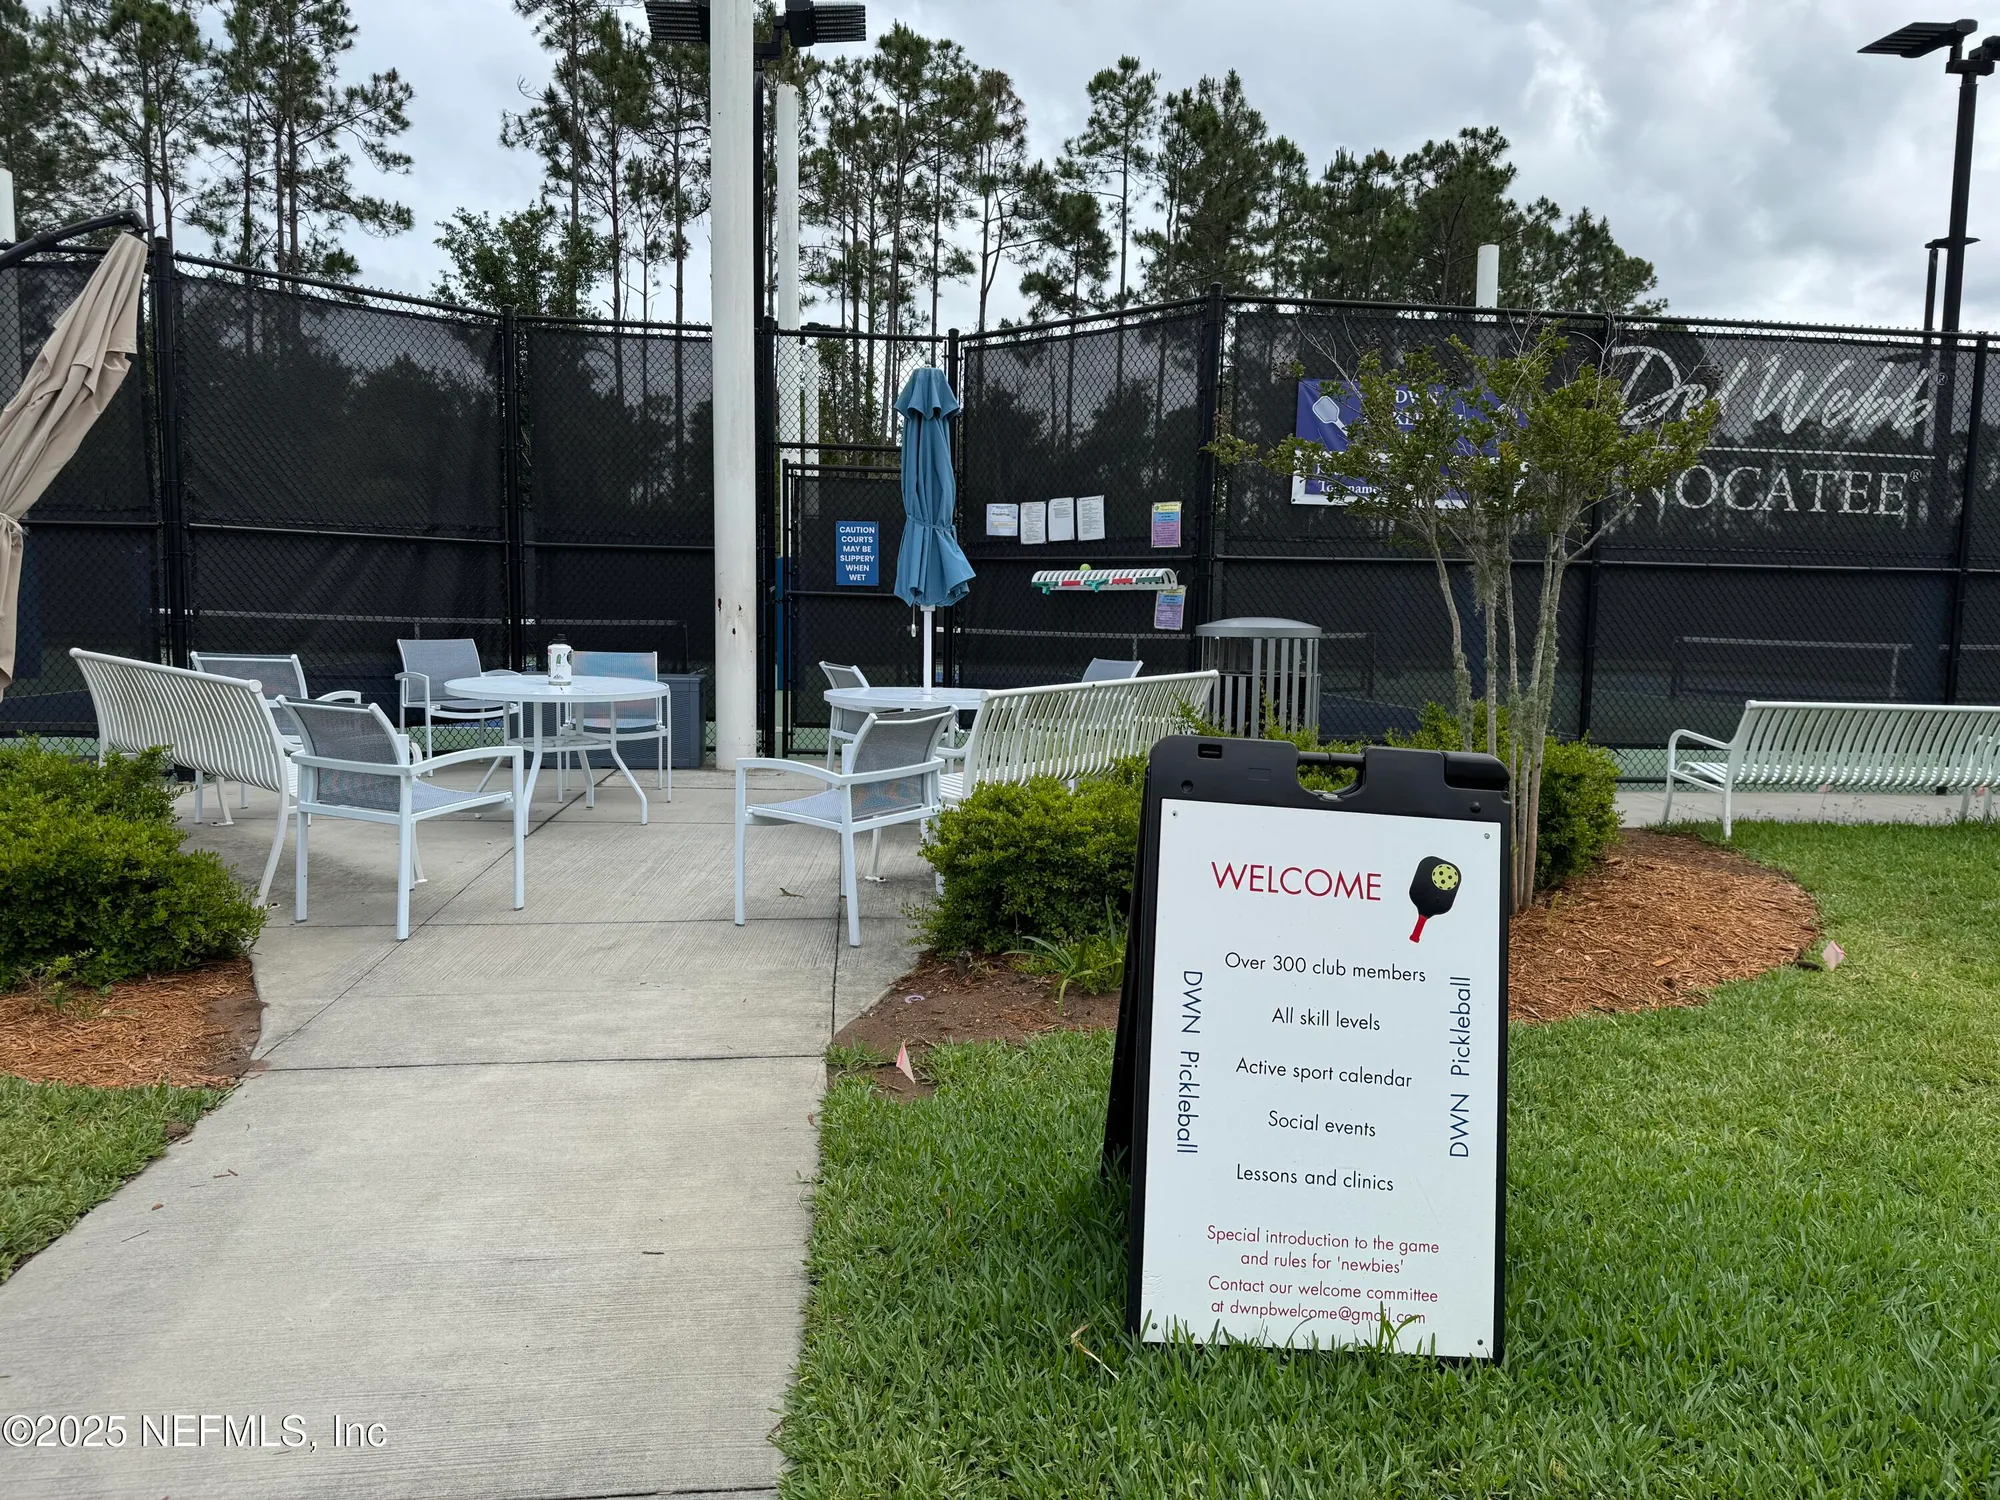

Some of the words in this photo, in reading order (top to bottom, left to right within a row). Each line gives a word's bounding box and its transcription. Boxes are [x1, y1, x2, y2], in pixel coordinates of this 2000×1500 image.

[1611, 345, 1749, 426] Del
[840, 526, 875, 534] CAUTION
[845, 564, 870, 572] WHEN
[1210, 861, 1382, 902] WELCOME
[1225, 951, 1266, 971] Over
[1272, 954, 1307, 974] 300
[1312, 957, 1347, 977] club
[1352, 962, 1427, 983] members
[1181, 970, 1203, 1034] DWN
[1271, 1006, 1294, 1024] All
[1299, 1008, 1330, 1027] skill
[1336, 1010, 1381, 1031] levels
[1449, 976, 1471, 1076] Pickleball
[1235, 1056, 1287, 1079] Active
[1292, 1066, 1334, 1084] sport
[1338, 1066, 1413, 1088] calendar
[1176, 1051, 1201, 1154] Pickleball
[1267, 1109, 1319, 1132] Social
[1324, 1120, 1376, 1138] events
[1449, 1093, 1470, 1158] DWN
[1236, 1162, 1298, 1184] Lessons
[1304, 1168, 1337, 1187] and
[1342, 1170, 1394, 1192] clinics
[1206, 1224, 1261, 1245] Special
[1265, 1229, 1349, 1250] introduction
[1354, 1235, 1368, 1250] to
[1372, 1234, 1395, 1251] the
[1398, 1241, 1440, 1257] game
[1240, 1251, 1269, 1267] and
[1274, 1253, 1307, 1269] rules
[1312, 1253, 1332, 1270] for
[1337, 1256, 1404, 1274] 'newbies'
[1208, 1274, 1265, 1294] Contact
[1269, 1282, 1293, 1295] our
[1298, 1281, 1362, 1300] welcome
[1366, 1286, 1439, 1303] committee
[1210, 1300, 1225, 1313] at
